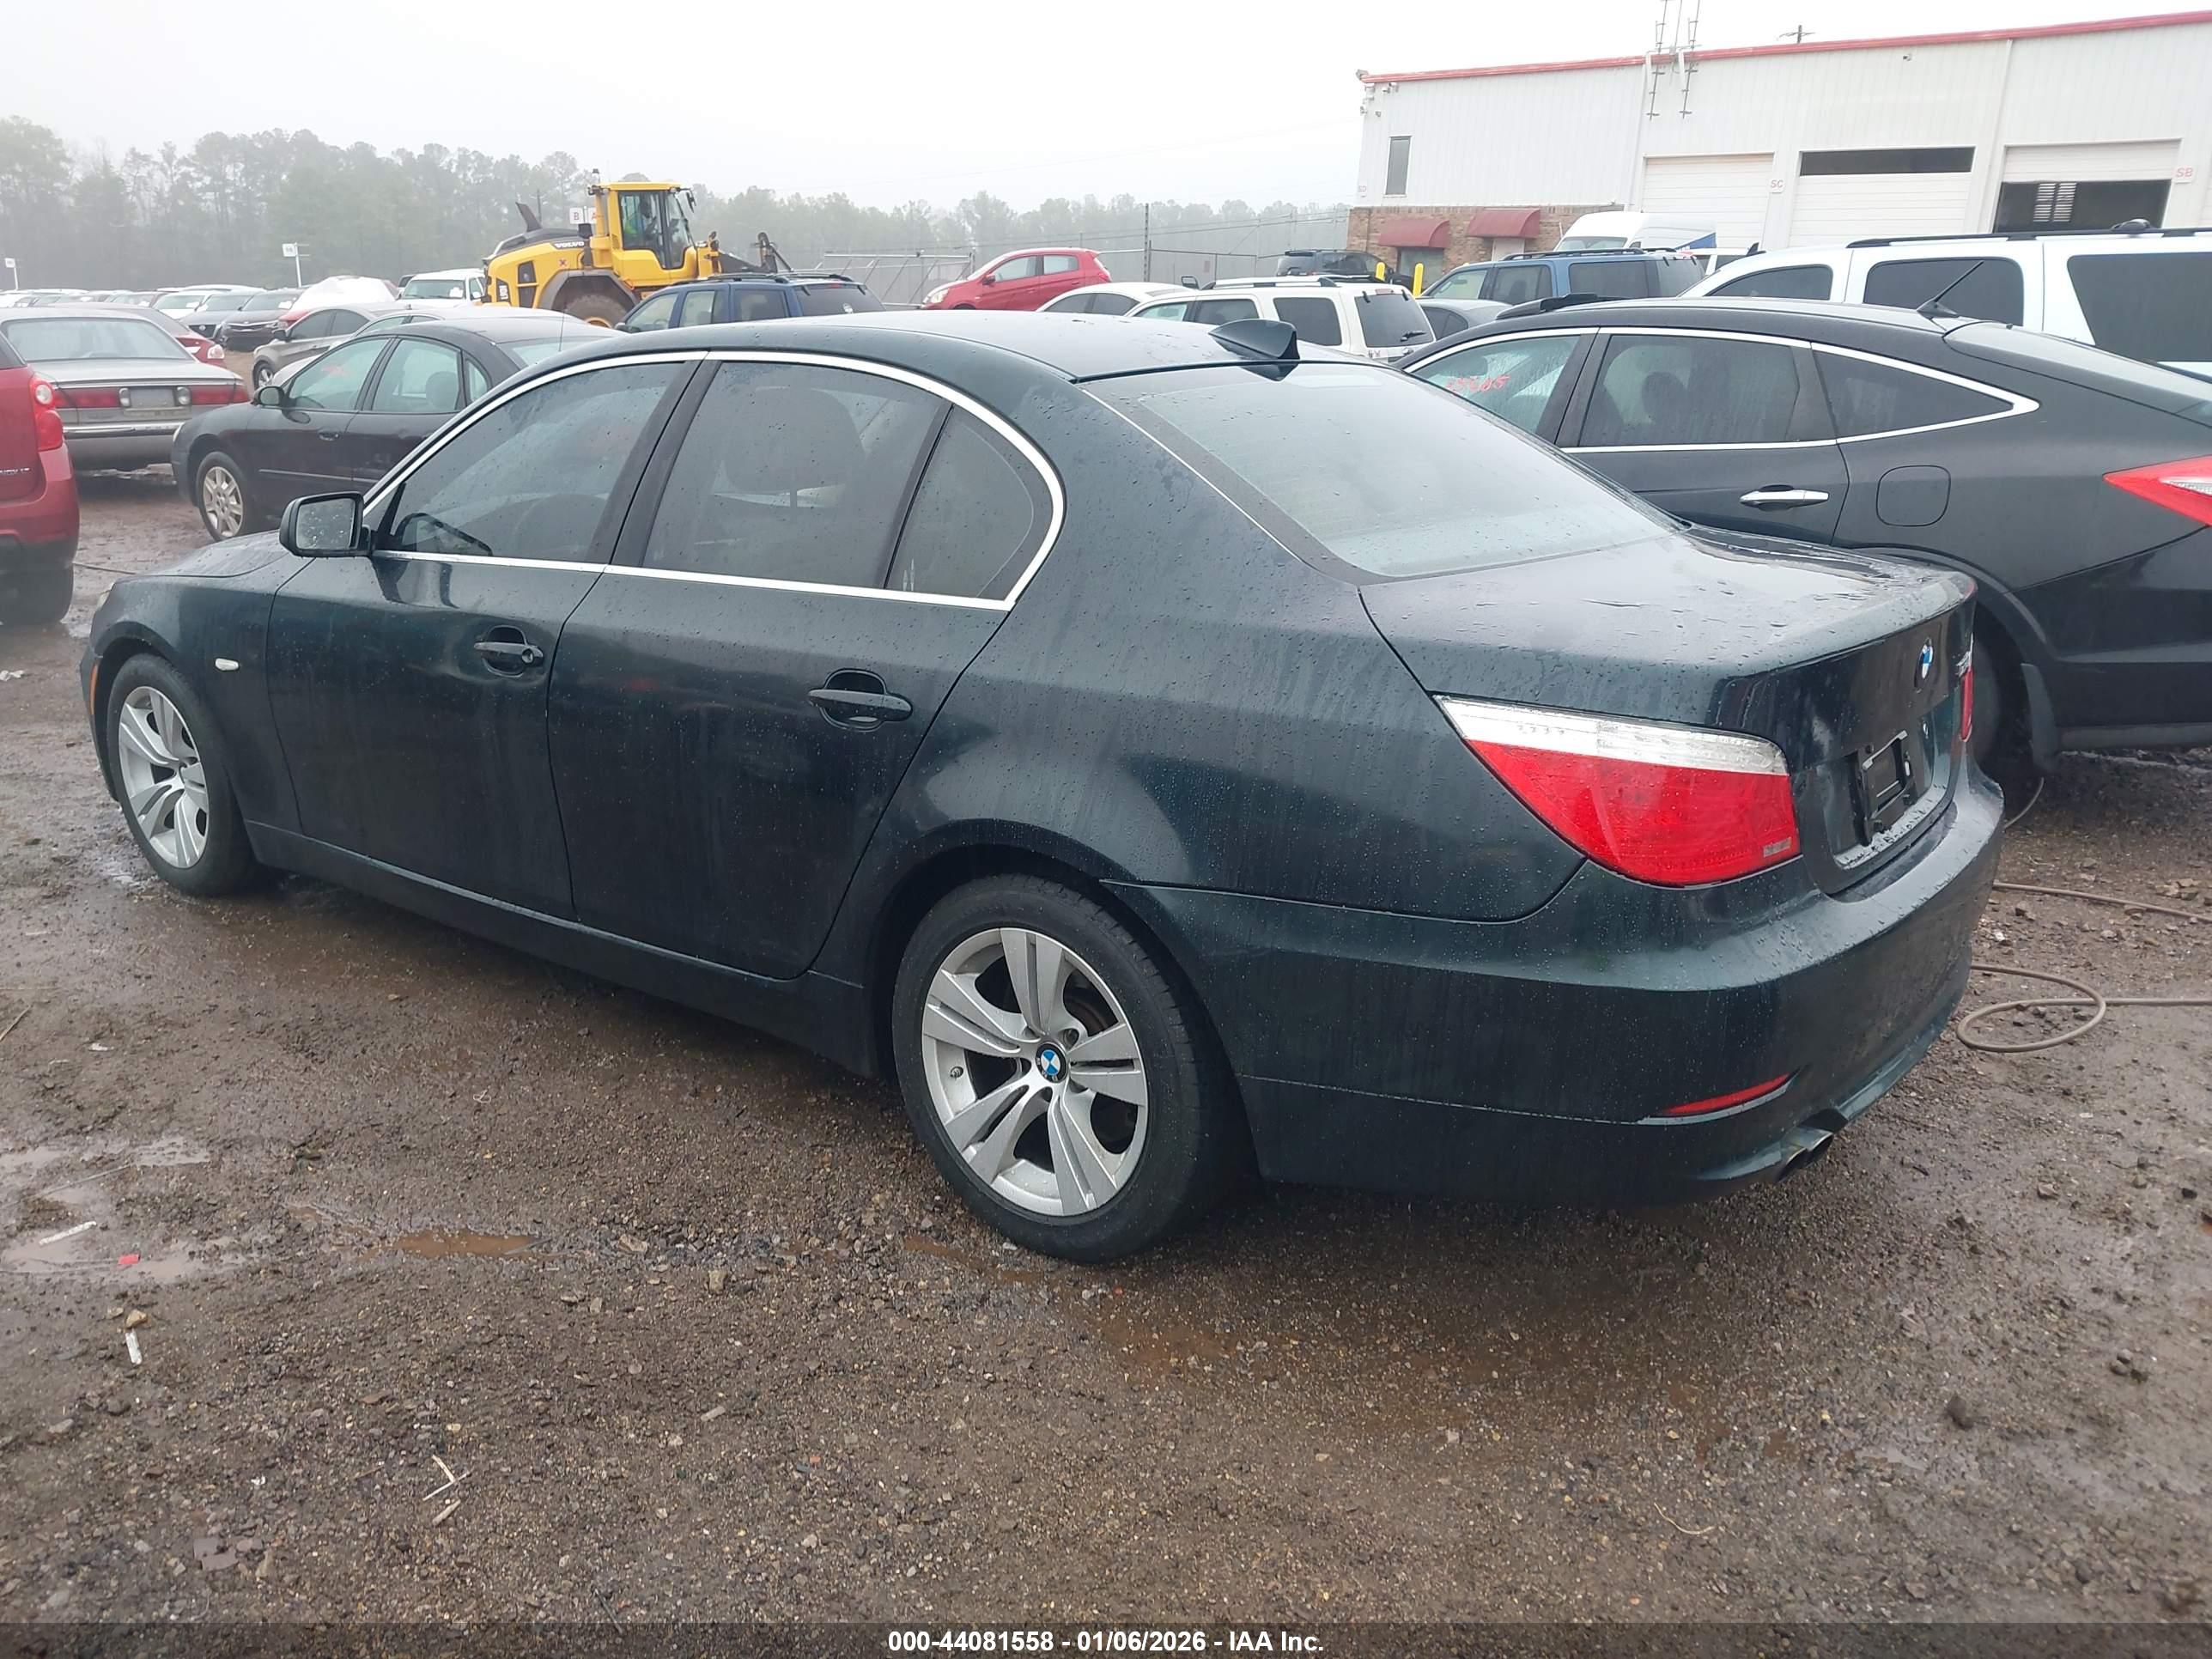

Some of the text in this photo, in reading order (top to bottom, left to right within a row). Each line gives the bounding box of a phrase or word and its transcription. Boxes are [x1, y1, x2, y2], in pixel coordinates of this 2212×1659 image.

[2176, 167, 2193, 178] SB
[1771, 179, 1784, 189] SC
[573, 211, 580, 221] B
